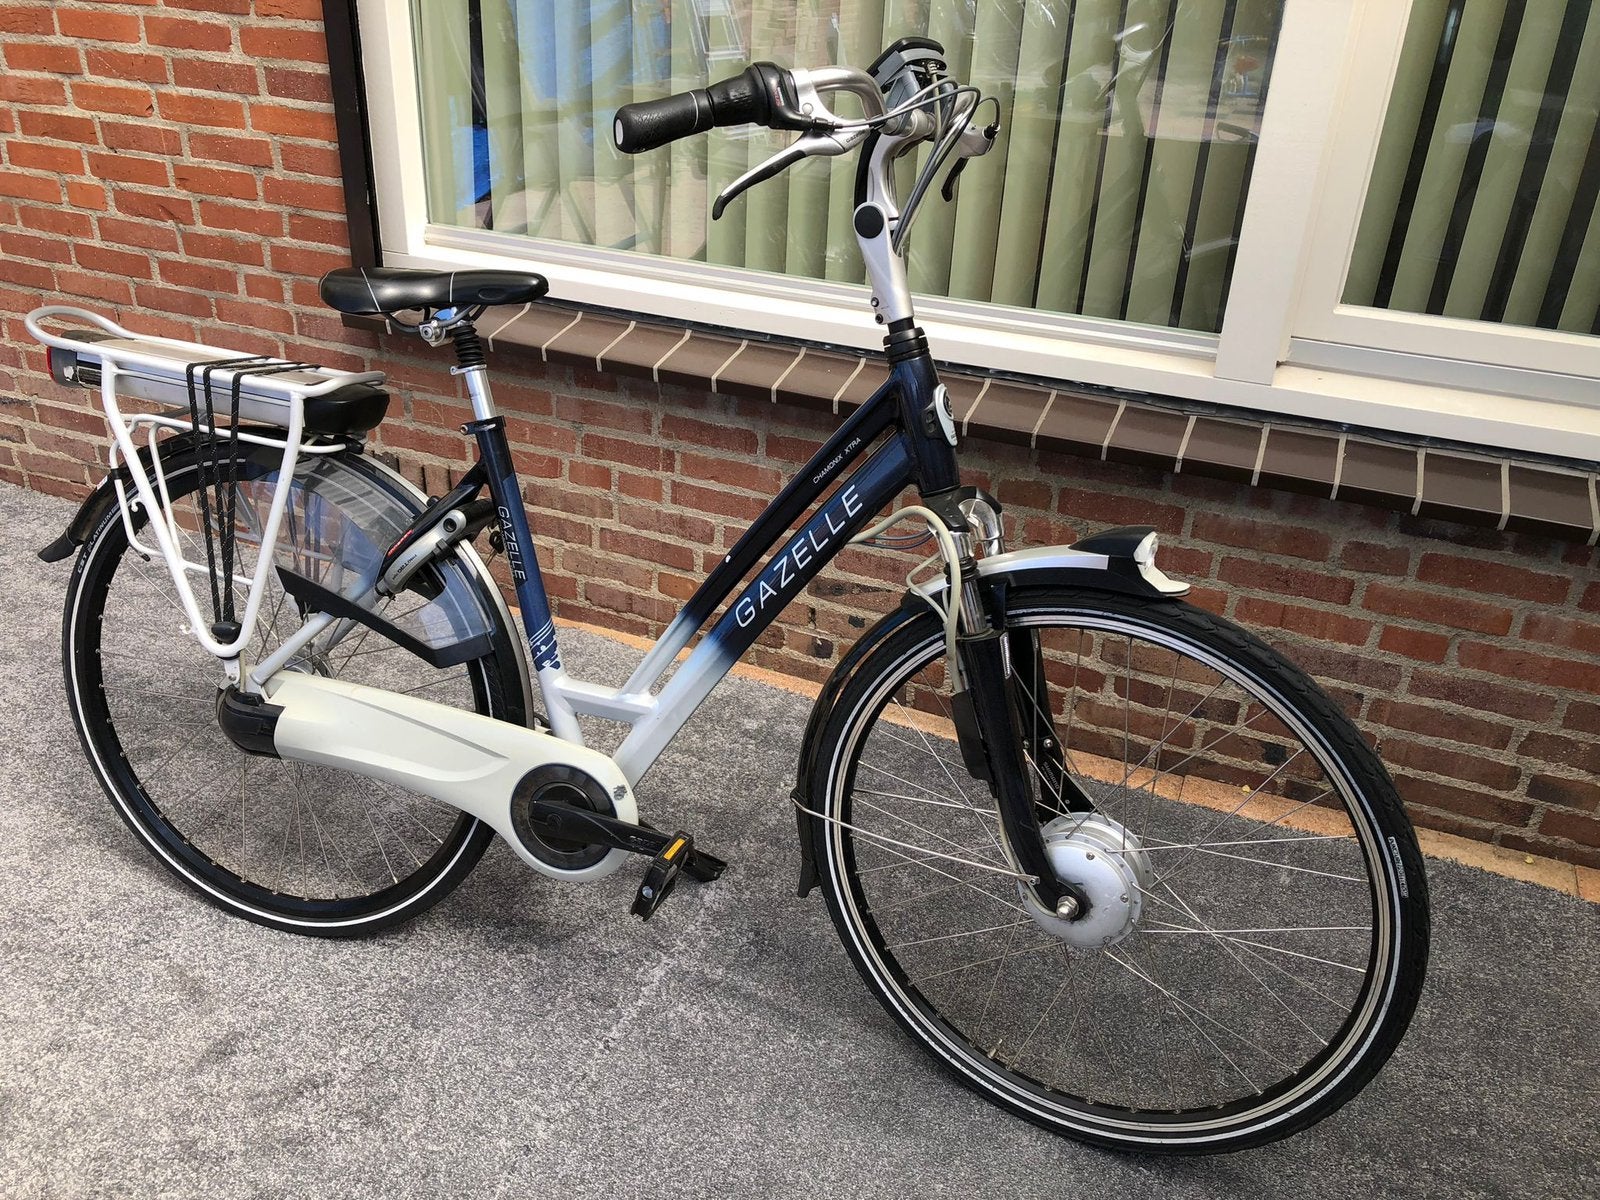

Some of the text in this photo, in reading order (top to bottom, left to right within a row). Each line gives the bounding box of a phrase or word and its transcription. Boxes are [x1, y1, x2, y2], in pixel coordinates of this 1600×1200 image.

[812, 437, 862, 484] CHAMONIX XTRA
[498, 506, 526, 580] GAZELLE
[735, 484, 863, 628] GAZELLE
